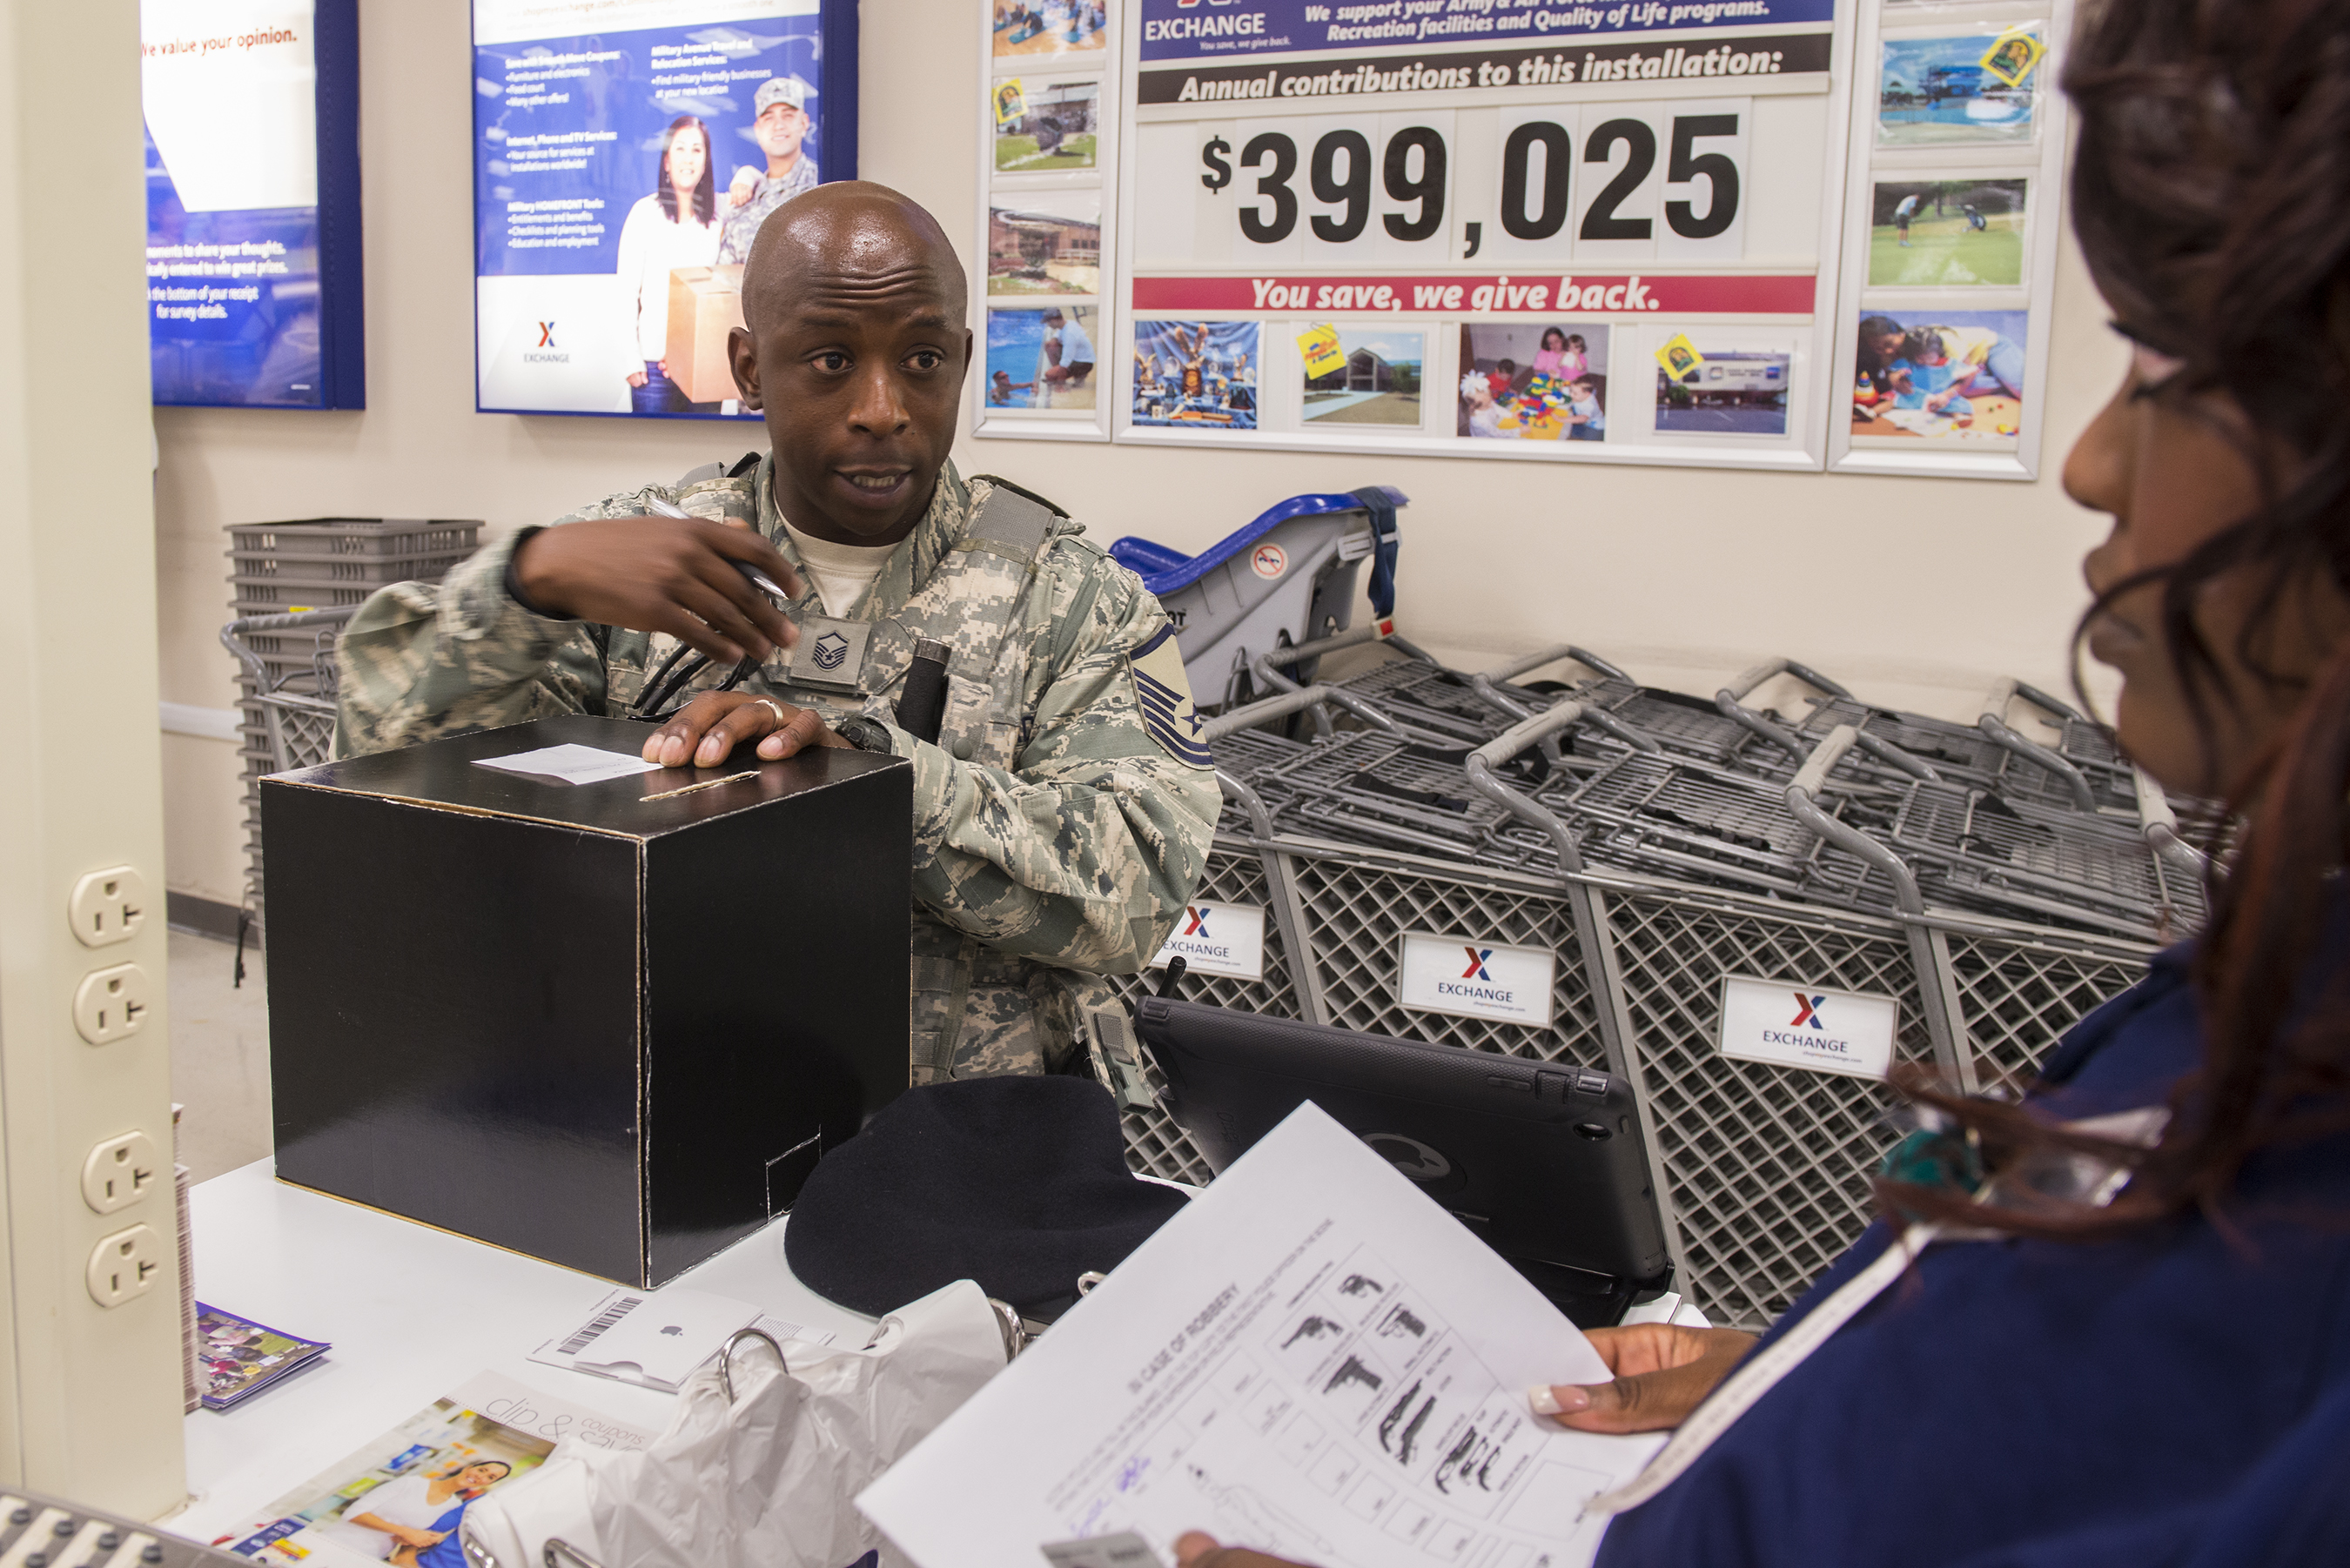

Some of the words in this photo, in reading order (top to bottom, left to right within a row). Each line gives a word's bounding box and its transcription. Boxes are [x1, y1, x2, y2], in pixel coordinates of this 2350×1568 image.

[1306, 5, 1331, 23] We
[1336, 2, 1402, 23] support
[1402, 0, 1445, 21] your
[1326, 18, 1417, 42] Recreation
[1416, 11, 1494, 40] facilities
[1496, 8, 1530, 30] and
[1534, 7, 1605, 31] Quality
[1606, 3, 1628, 29] of
[1630, 1, 1668, 27] Life
[1669, 1, 1771, 24] programs.
[1145, 13, 1266, 41] EXCHANGE
[160, 37, 197, 55] value
[201, 37, 232, 57] your
[237, 26, 298, 51] opinion.
[1199, 42, 1214, 50] You
[1216, 41, 1237, 50] save,
[1250, 37, 1268, 50] give
[1268, 36, 1292, 46] back.
[730, 69, 772, 80] businesses
[1178, 70, 1278, 102] Annual
[1279, 61, 1472, 97] contributions
[1478, 61, 1511, 87] to
[1517, 54, 1576, 85] this
[1581, 44, 1784, 83] installation:
[664, 89, 682, 100] your
[682, 88, 697, 97] new
[526, 150, 548, 159] source
[548, 146, 560, 158] for
[560, 146, 587, 157] services
[553, 211, 566, 223] and
[566, 210, 594, 222] benefits
[545, 224, 558, 235] and
[558, 224, 588, 237] planning
[588, 223, 606, 234] tools
[183, 244, 194, 258] to
[194, 242, 218, 258] share
[218, 244, 240, 259] your
[241, 239, 286, 258] thoughts.
[544, 236, 557, 247] and
[557, 236, 600, 249] employment
[168, 260, 204, 276] entered
[204, 261, 215, 275] to
[215, 259, 232, 275] win
[232, 260, 257, 278] great
[257, 258, 289, 278] prizes.
[151, 285, 166, 301] the
[166, 285, 198, 301] bottom
[198, 285, 209, 300] of
[208, 288, 228, 304] your
[1252, 278, 1311, 309] You
[1315, 284, 1402, 312] save,
[1413, 284, 1463, 310] we
[1472, 276, 1549, 312] give
[1555, 276, 1660, 310] back.
[156, 303, 170, 318] for
[170, 306, 197, 322] survey
[197, 303, 228, 318] details.
[524, 353, 570, 364] EXCHANGE
[1164, 940, 1230, 958] EXCHANGE
[1438, 982, 1514, 1003] EXCHANGE
[1763, 1030, 1849, 1053] EXCHANGE
[1139, 1348, 1175, 1383] CASE
[1169, 1333, 1189, 1354] OF
[1185, 1281, 1241, 1338] ROBBERY
[486, 1397, 538, 1426] clip
[538, 1414, 573, 1438] &
[581, 1417, 646, 1445] coupons
